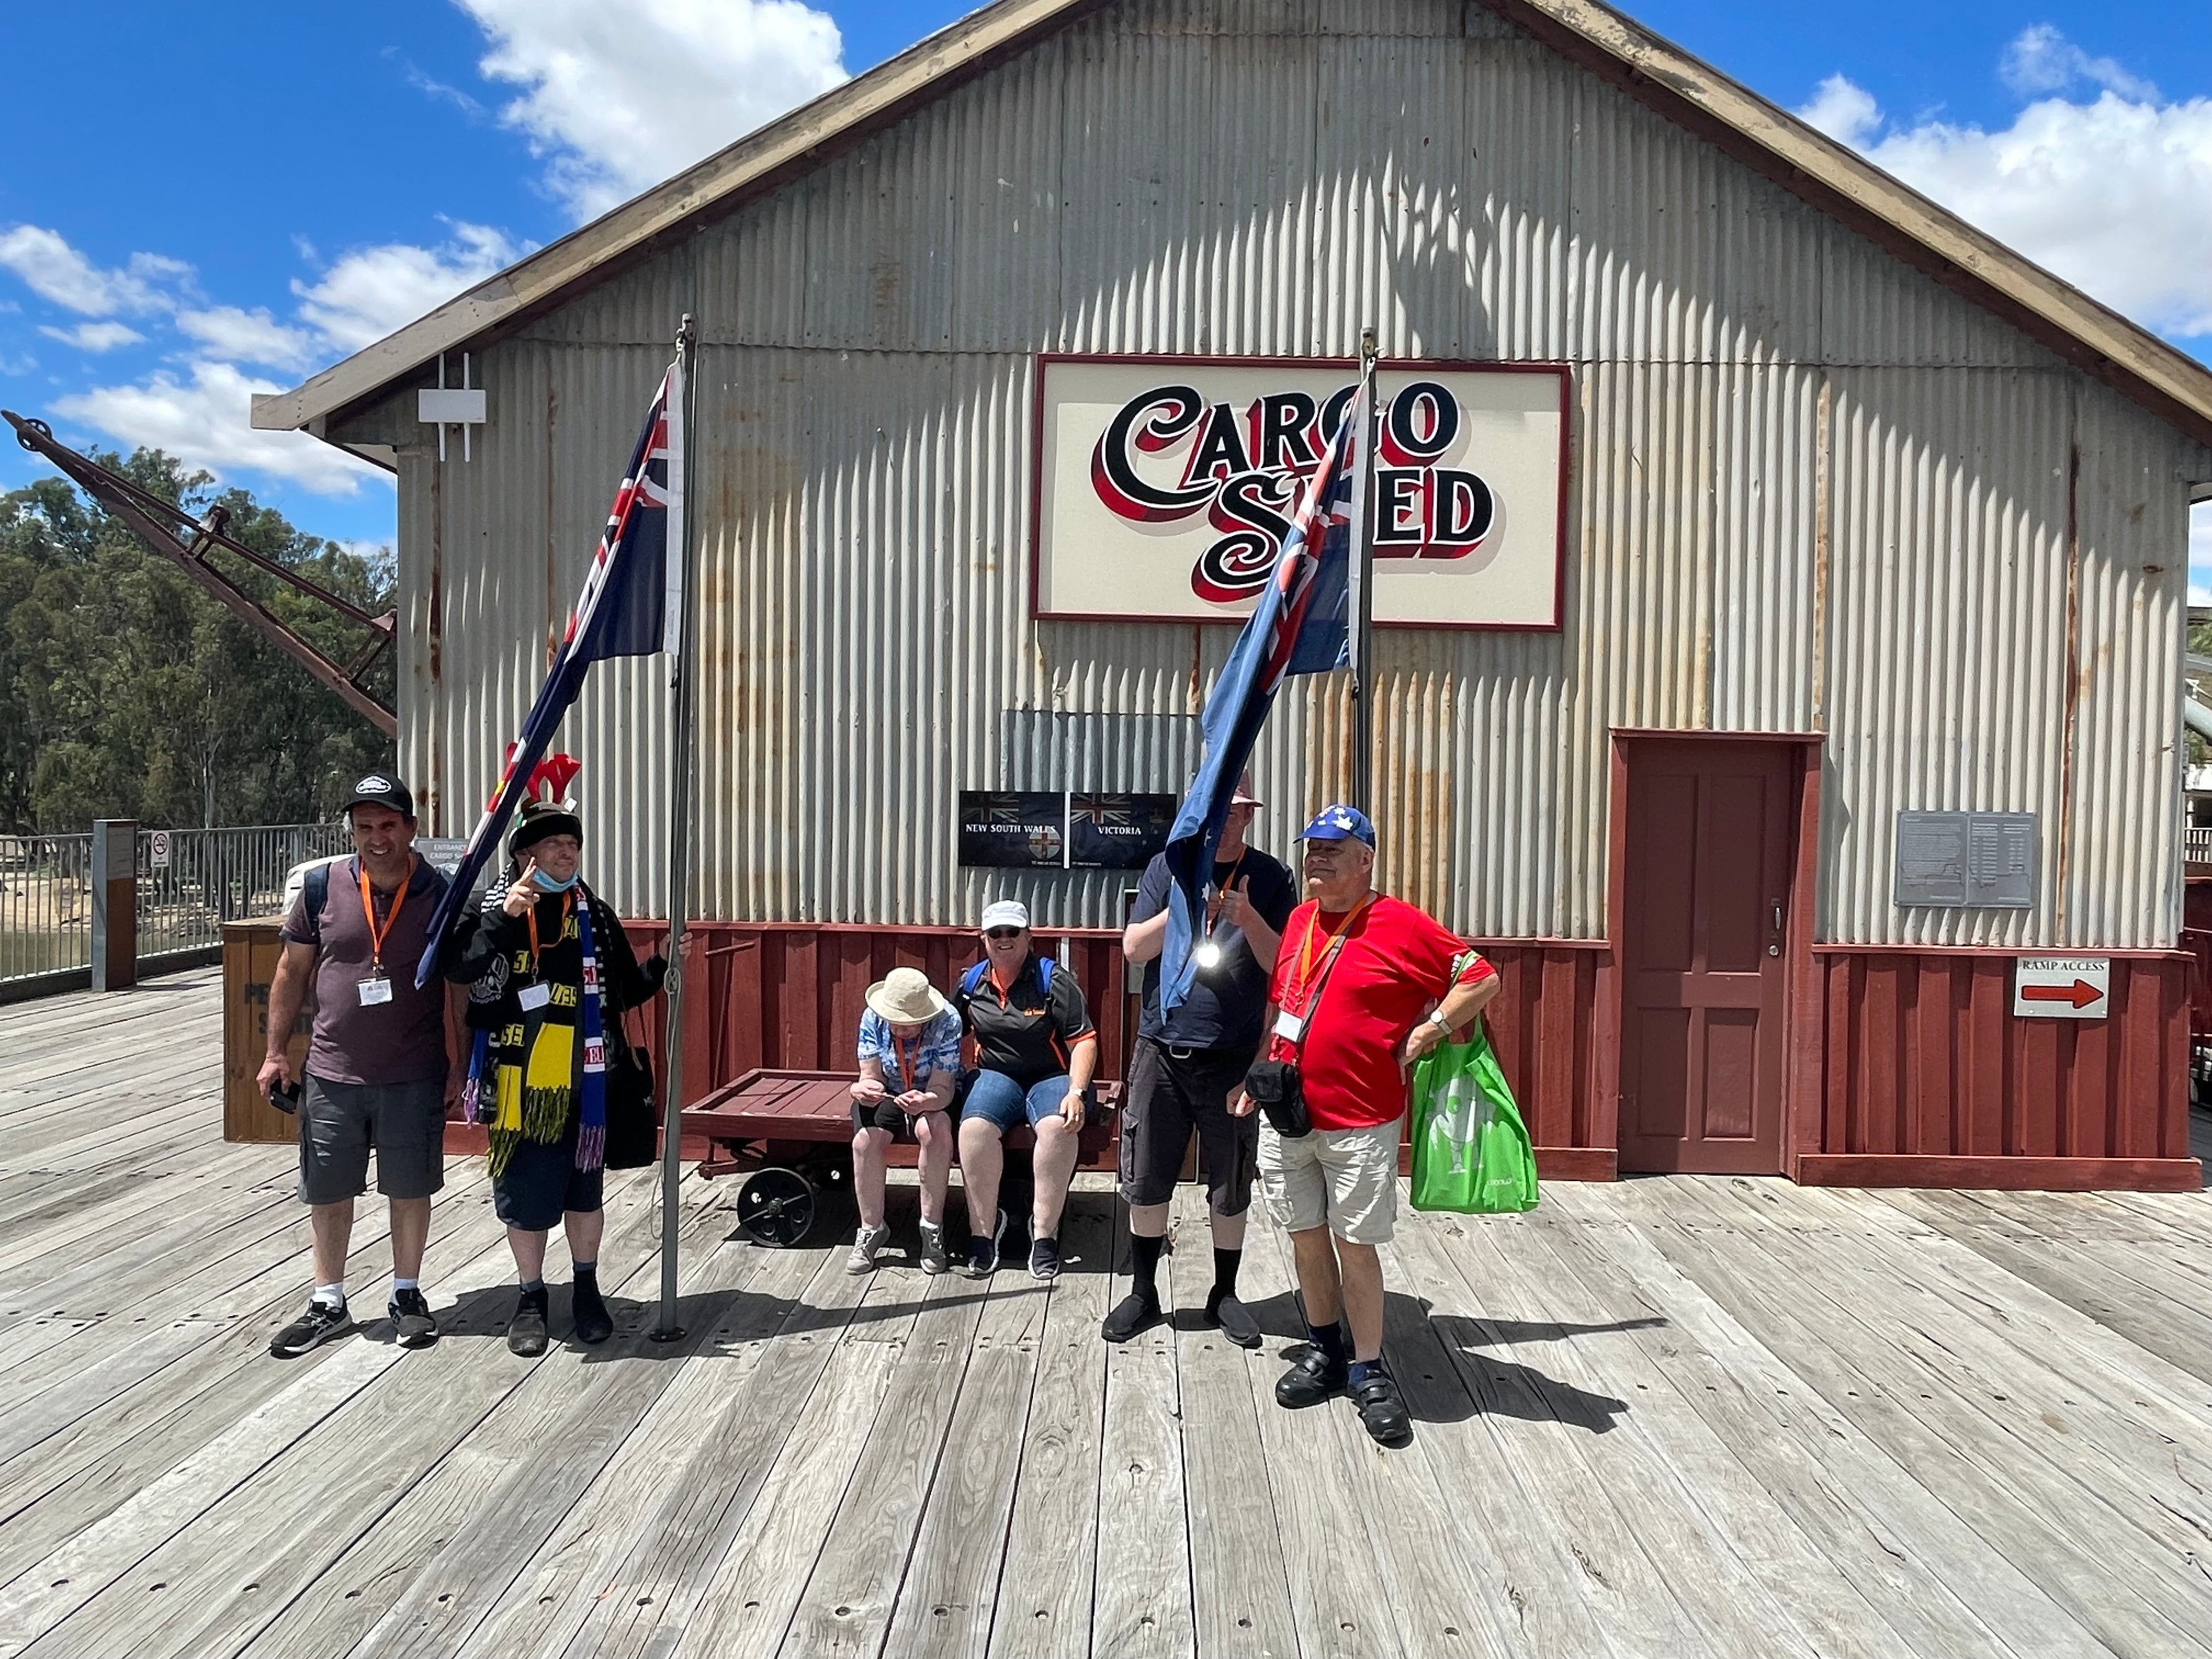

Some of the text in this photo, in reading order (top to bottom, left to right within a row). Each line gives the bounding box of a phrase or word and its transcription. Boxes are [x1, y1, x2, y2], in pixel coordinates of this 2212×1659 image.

[1192, 466, 1497, 602] SED
[966, 824, 1057, 834] NEW SOUTH WALES
[1098, 826, 1141, 835] VICTORIA
[2022, 960, 2104, 971] RAMP ACCESS
